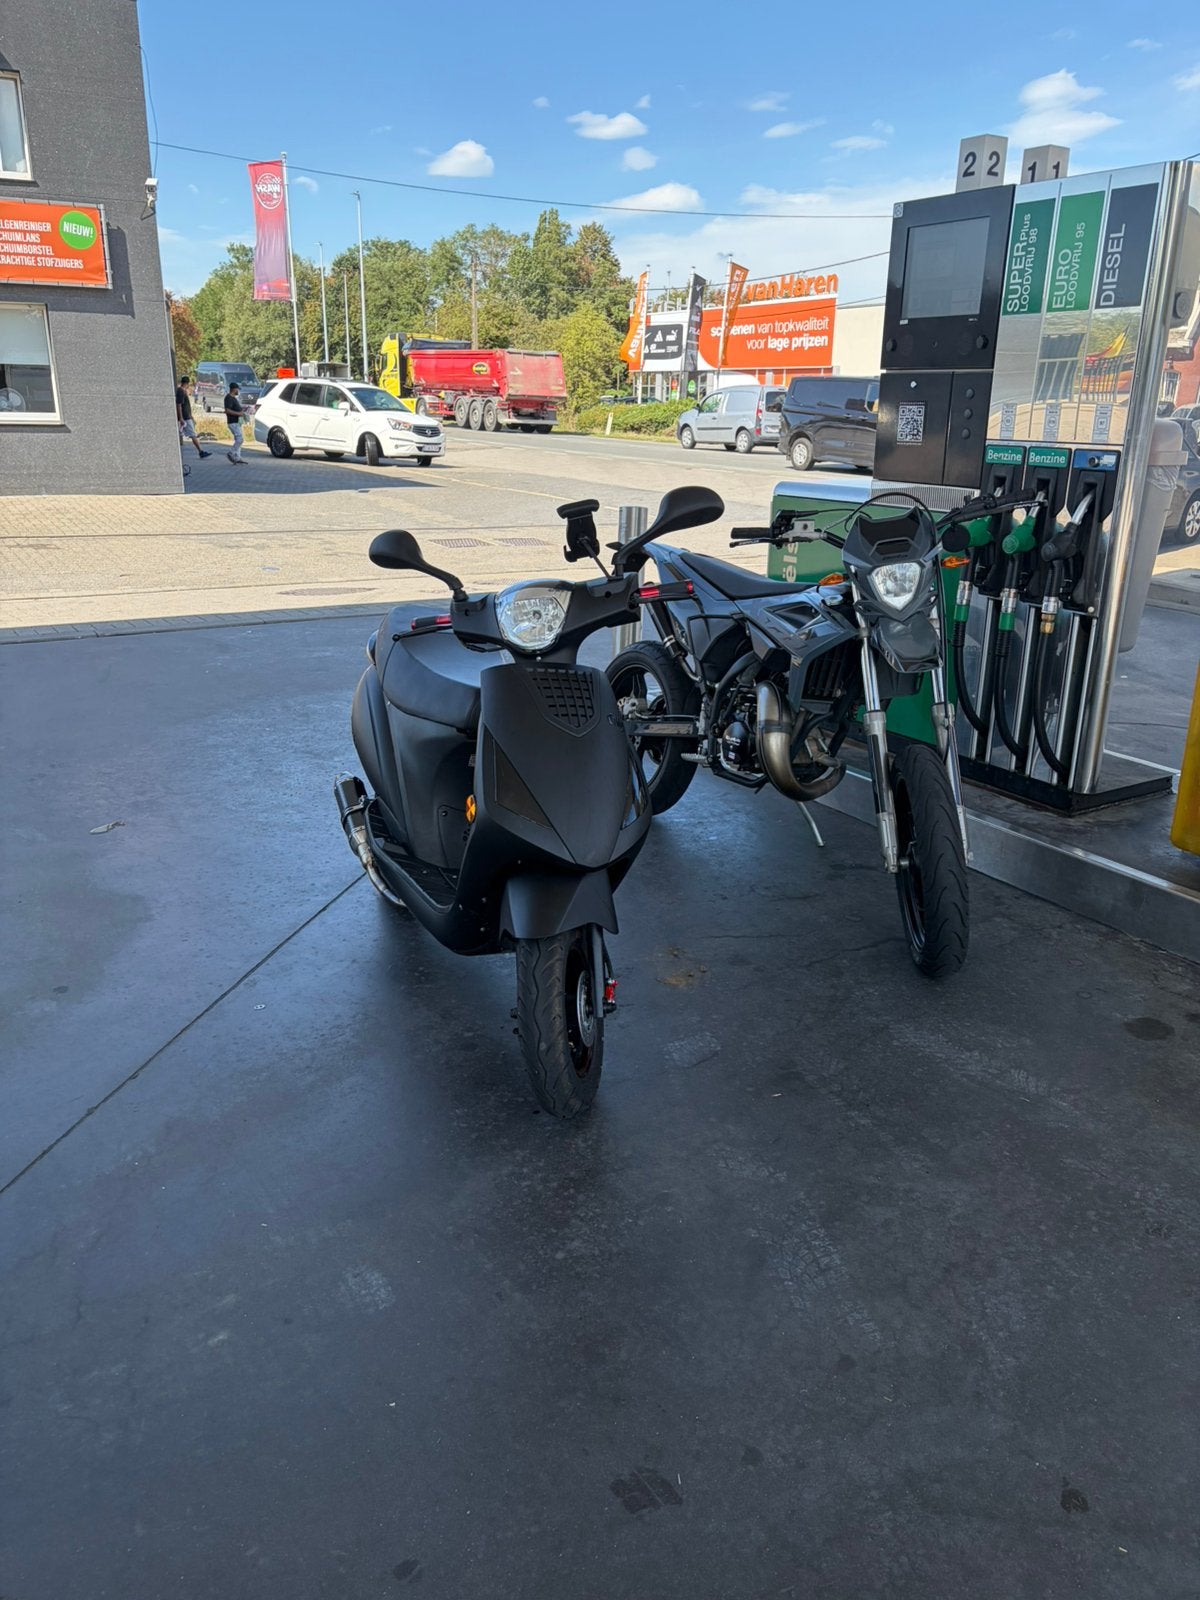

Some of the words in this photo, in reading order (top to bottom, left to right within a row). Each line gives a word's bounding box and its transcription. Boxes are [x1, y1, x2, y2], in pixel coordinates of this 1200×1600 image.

[962, 151, 977, 178] 2
[987, 150, 1001, 177] 2
[1028, 161, 1037, 183] 1
[1052, 161, 1060, 179] 1
[0, 219, 52, 232] LGENREINIGER
[63, 221, 94, 238] NIEUW!
[0, 254, 37, 266] RACHTIGE
[37, 257, 84, 269] STOFZUIGERS
[1020, 247, 1036, 312] LOODVRIJ
[1028, 228, 1039, 243] 98
[1066, 242, 1084, 308] LOODVRIJ
[1075, 222, 1086, 238] 95
[1100, 223, 1126, 306] DIESEL
[745, 273, 839, 300] vanHaren
[1052, 248, 1072, 309] EURO
[757, 322, 773, 334] van
[775, 316, 829, 334] topkwaliteit
[746, 338, 766, 350] voor
[768, 335, 790, 352] lage
[791, 334, 828, 351] prijzen
[987, 449, 1022, 462] Benzine
[1029, 452, 1066, 464] Benzine
